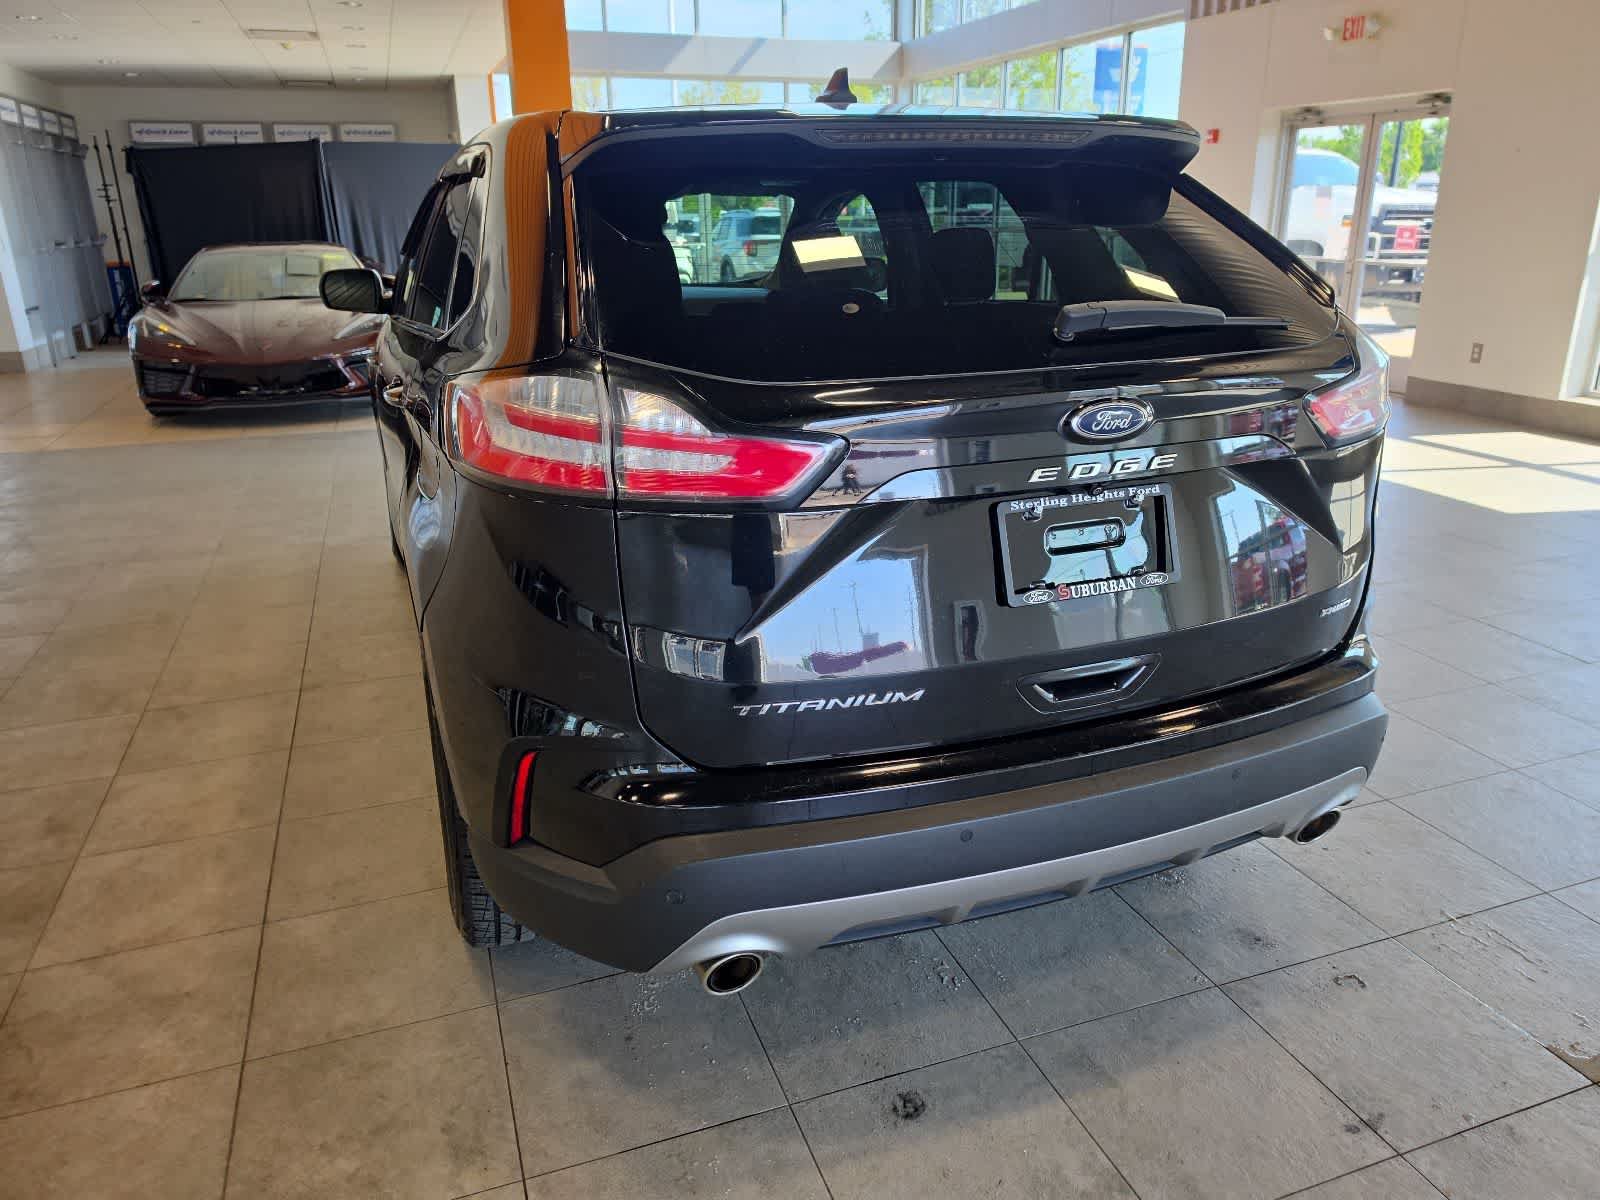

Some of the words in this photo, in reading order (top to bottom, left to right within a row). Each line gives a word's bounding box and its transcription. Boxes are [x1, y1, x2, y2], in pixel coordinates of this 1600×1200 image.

[1342, 15, 1366, 41] EXIT
[1090, 409, 1133, 432] Ford
[1028, 453, 1178, 484] EDGE
[1010, 496, 1068, 512] Sterling
[1071, 489, 1126, 503] Heights
[1128, 483, 1161, 498] Ford
[1057, 576, 1136, 600] SUBURBAN
[733, 687, 926, 717] TITANIUM
